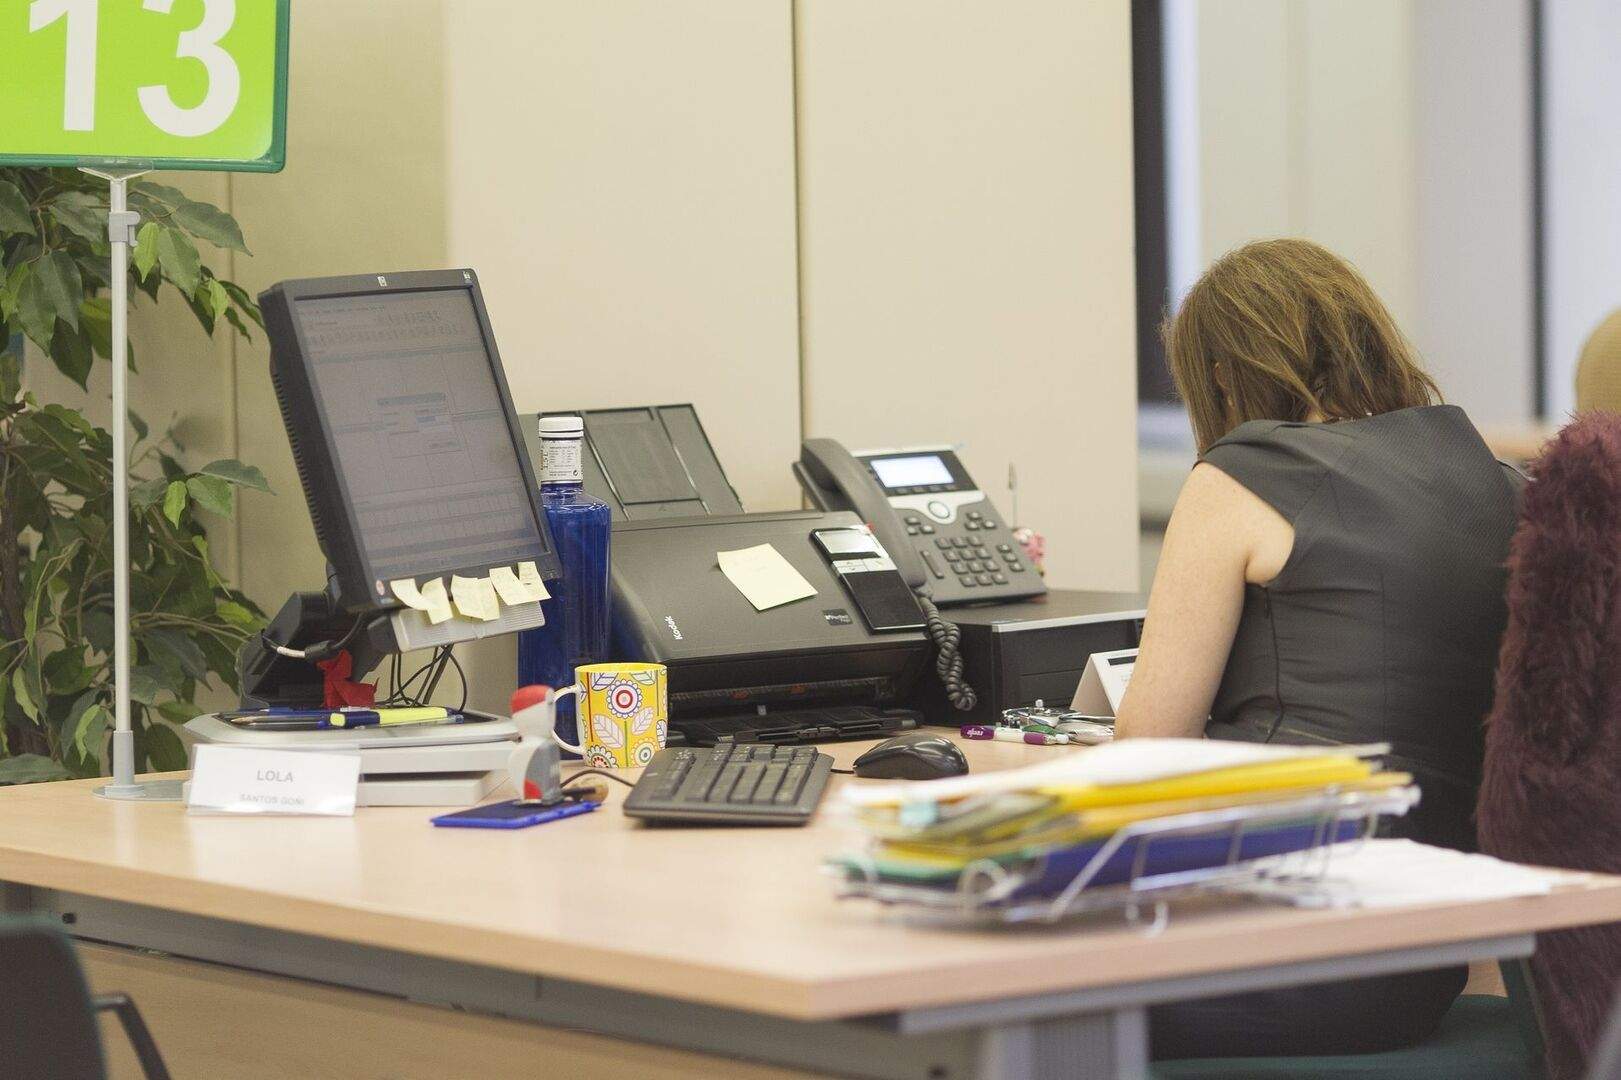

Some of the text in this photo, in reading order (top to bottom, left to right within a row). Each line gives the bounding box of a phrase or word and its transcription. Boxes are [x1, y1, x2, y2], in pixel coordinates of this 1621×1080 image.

[29, 0, 240, 137] 13
[256, 769, 294, 783] LOLA
[240, 793, 278, 804] SANTOS
